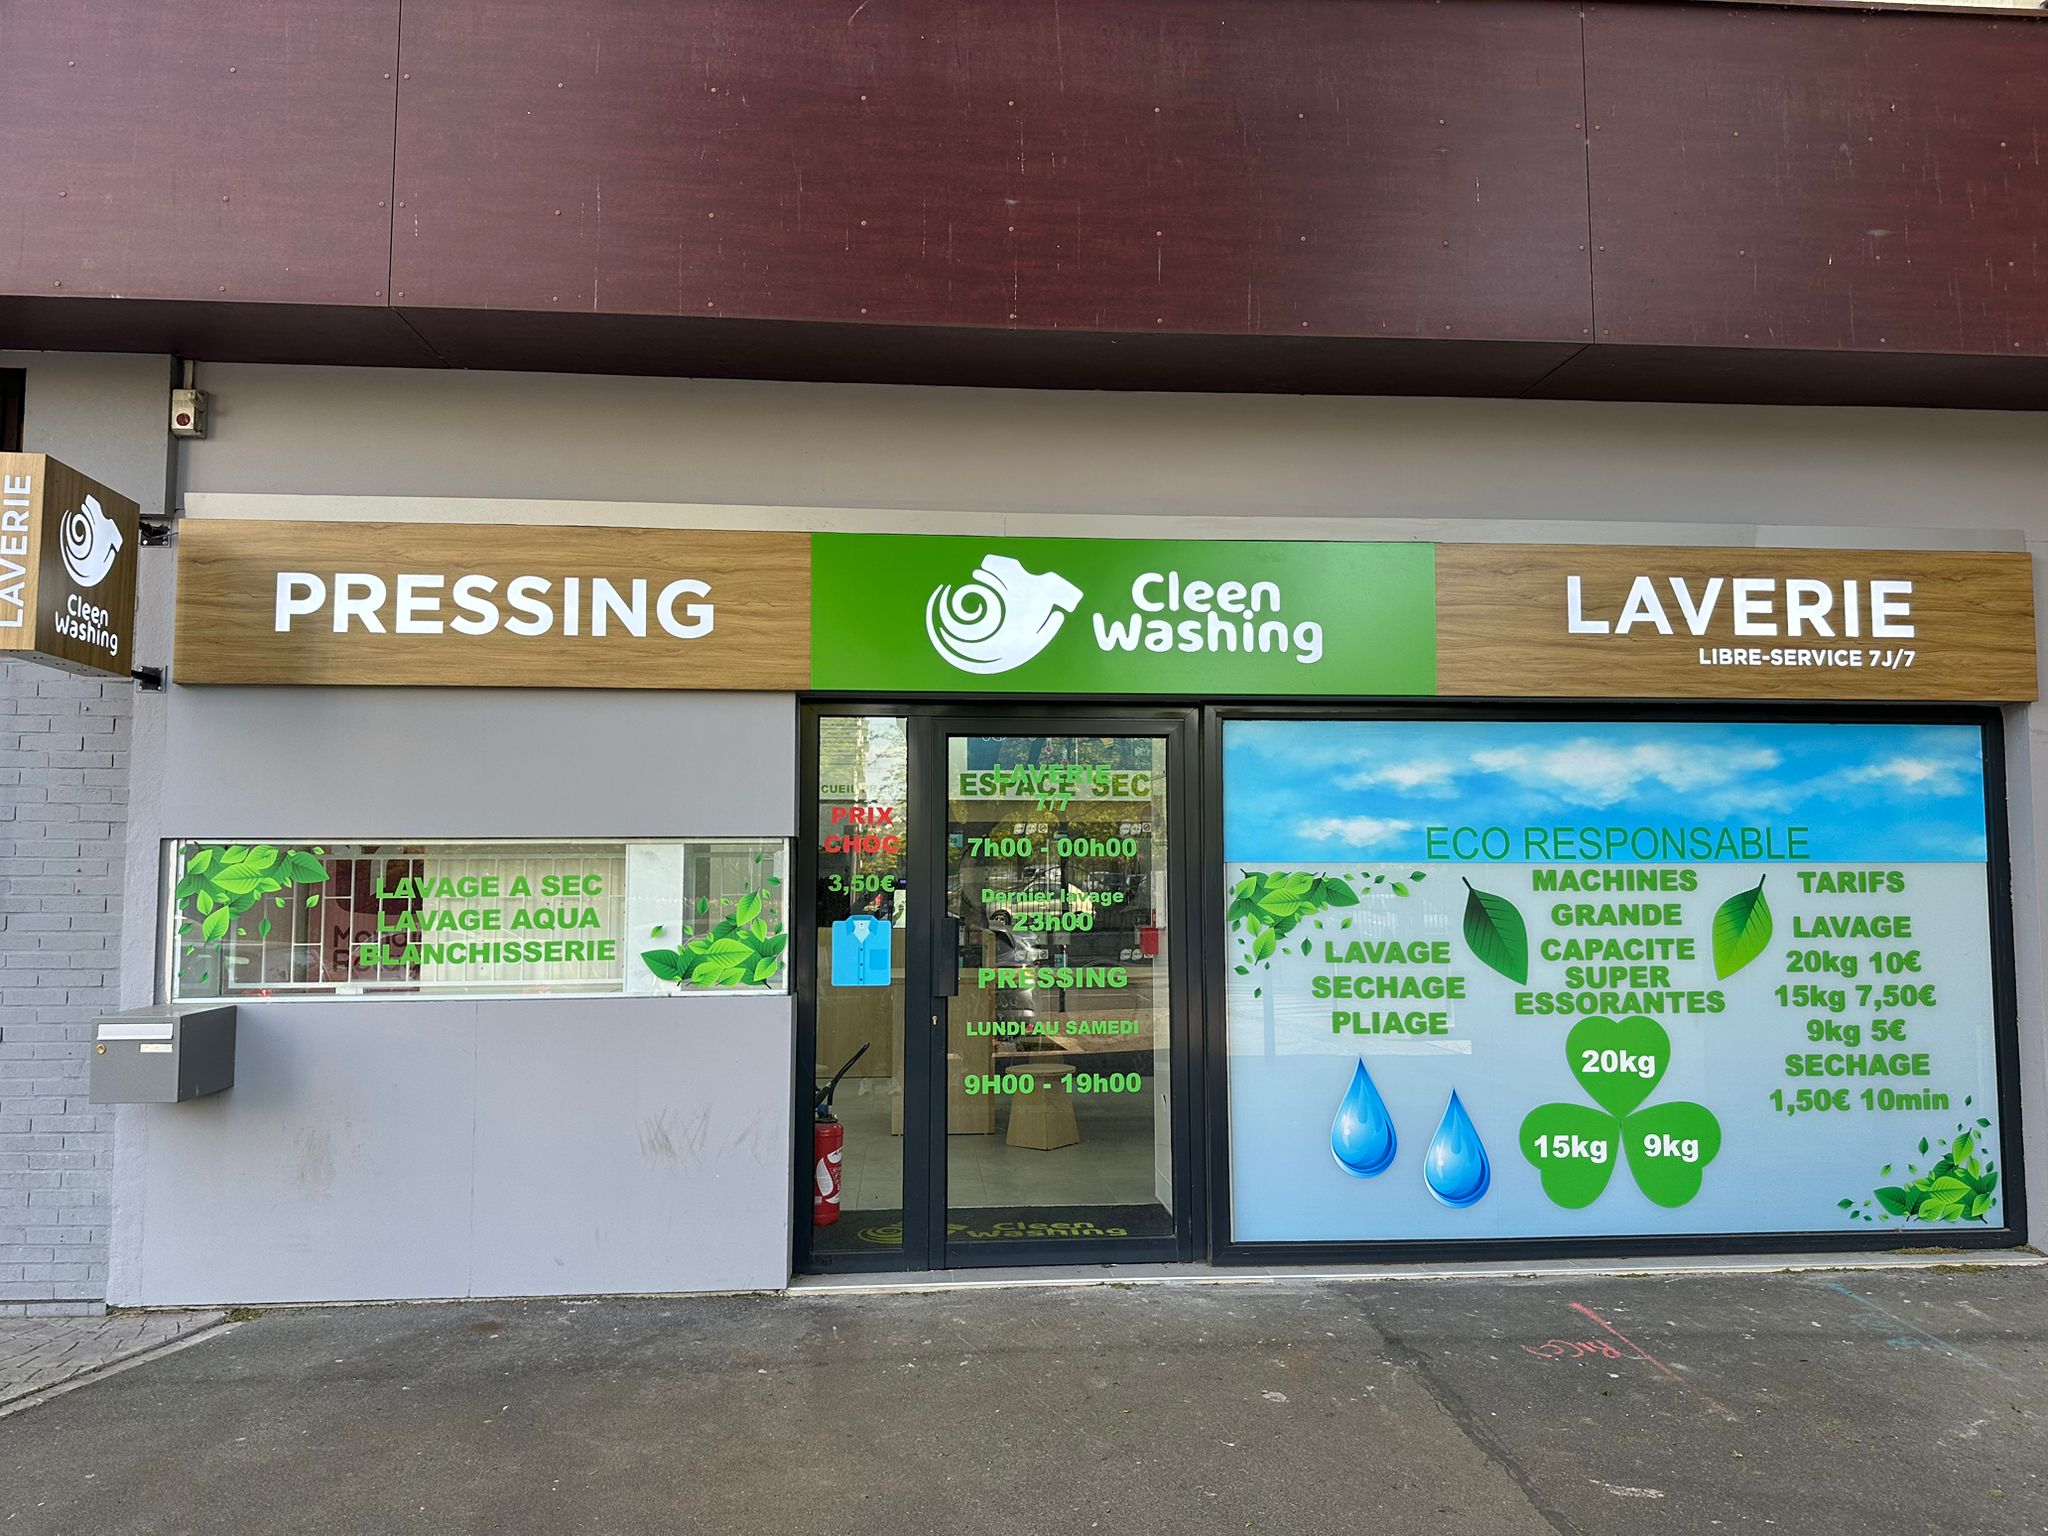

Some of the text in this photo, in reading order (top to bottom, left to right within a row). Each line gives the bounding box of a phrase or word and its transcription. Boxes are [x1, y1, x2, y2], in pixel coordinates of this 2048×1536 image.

[0, 475, 31, 628] LAVERIE
[1132, 571, 1281, 611] Cleen
[67, 594, 108, 627] Cleen
[275, 572, 714, 638] PRESSING
[1567, 575, 1916, 638] LAVERIE
[55, 610, 118, 656] Washing
[1093, 604, 1324, 664] Washing
[1699, 647, 1917, 669] LIBRE-SERVICE 7J/7
[959, 773, 1150, 797] ESPACE SEC
[993, 763, 1112, 785] LAVERIE
[1033, 793, 1072, 812] 7/7
[831, 806, 893, 825] PRIX
[823, 834, 901, 854] CHOC
[967, 837, 1033, 858] 7h00
[1057, 837, 1138, 858] 00h00
[1426, 827, 1810, 860] ECO RESPONSABLE
[375, 873, 603, 899] LAVAGE A SEC
[828, 873, 896, 896] 3,50€
[1532, 869, 1698, 892] MACHINES
[1797, 870, 1906, 893] TARIFS
[981, 888, 1125, 907] Dernier lavage
[377, 907, 601, 933] LAVAGE AQUA
[1012, 910, 1094, 932] 23h00
[1551, 903, 1683, 927] GRANDE
[1793, 915, 1912, 939] LAVAGE
[359, 939, 616, 967] BLANCHISSERIE
[1324, 940, 1451, 965] LAVAGE
[1540, 937, 1696, 962] CAPACITE
[1786, 950, 1922, 978] 20kg 10€
[978, 966, 1128, 989] PRESSING
[1311, 975, 1466, 999] SECHAGE
[1564, 965, 1671, 989] SUPER
[1514, 990, 1727, 1015] ESSORANTES
[1774, 984, 1937, 1012] 15kg 7,50€
[966, 1020, 1139, 1036] LUNDI AU SAMEDI
[1331, 1011, 1449, 1035] PLIAGE
[1806, 1018, 1907, 1047] 9kg 5€
[1581, 1049, 1656, 1079] 20kg
[1784, 1053, 1931, 1077] SECHAGE
[964, 1074, 1035, 1095] 9H00
[1060, 1072, 1142, 1094] 19h00
[1769, 1087, 1950, 1117] 1,50€ 10min
[1534, 1134, 1608, 1164] 15kg
[1643, 1133, 1699, 1163] 9kg
